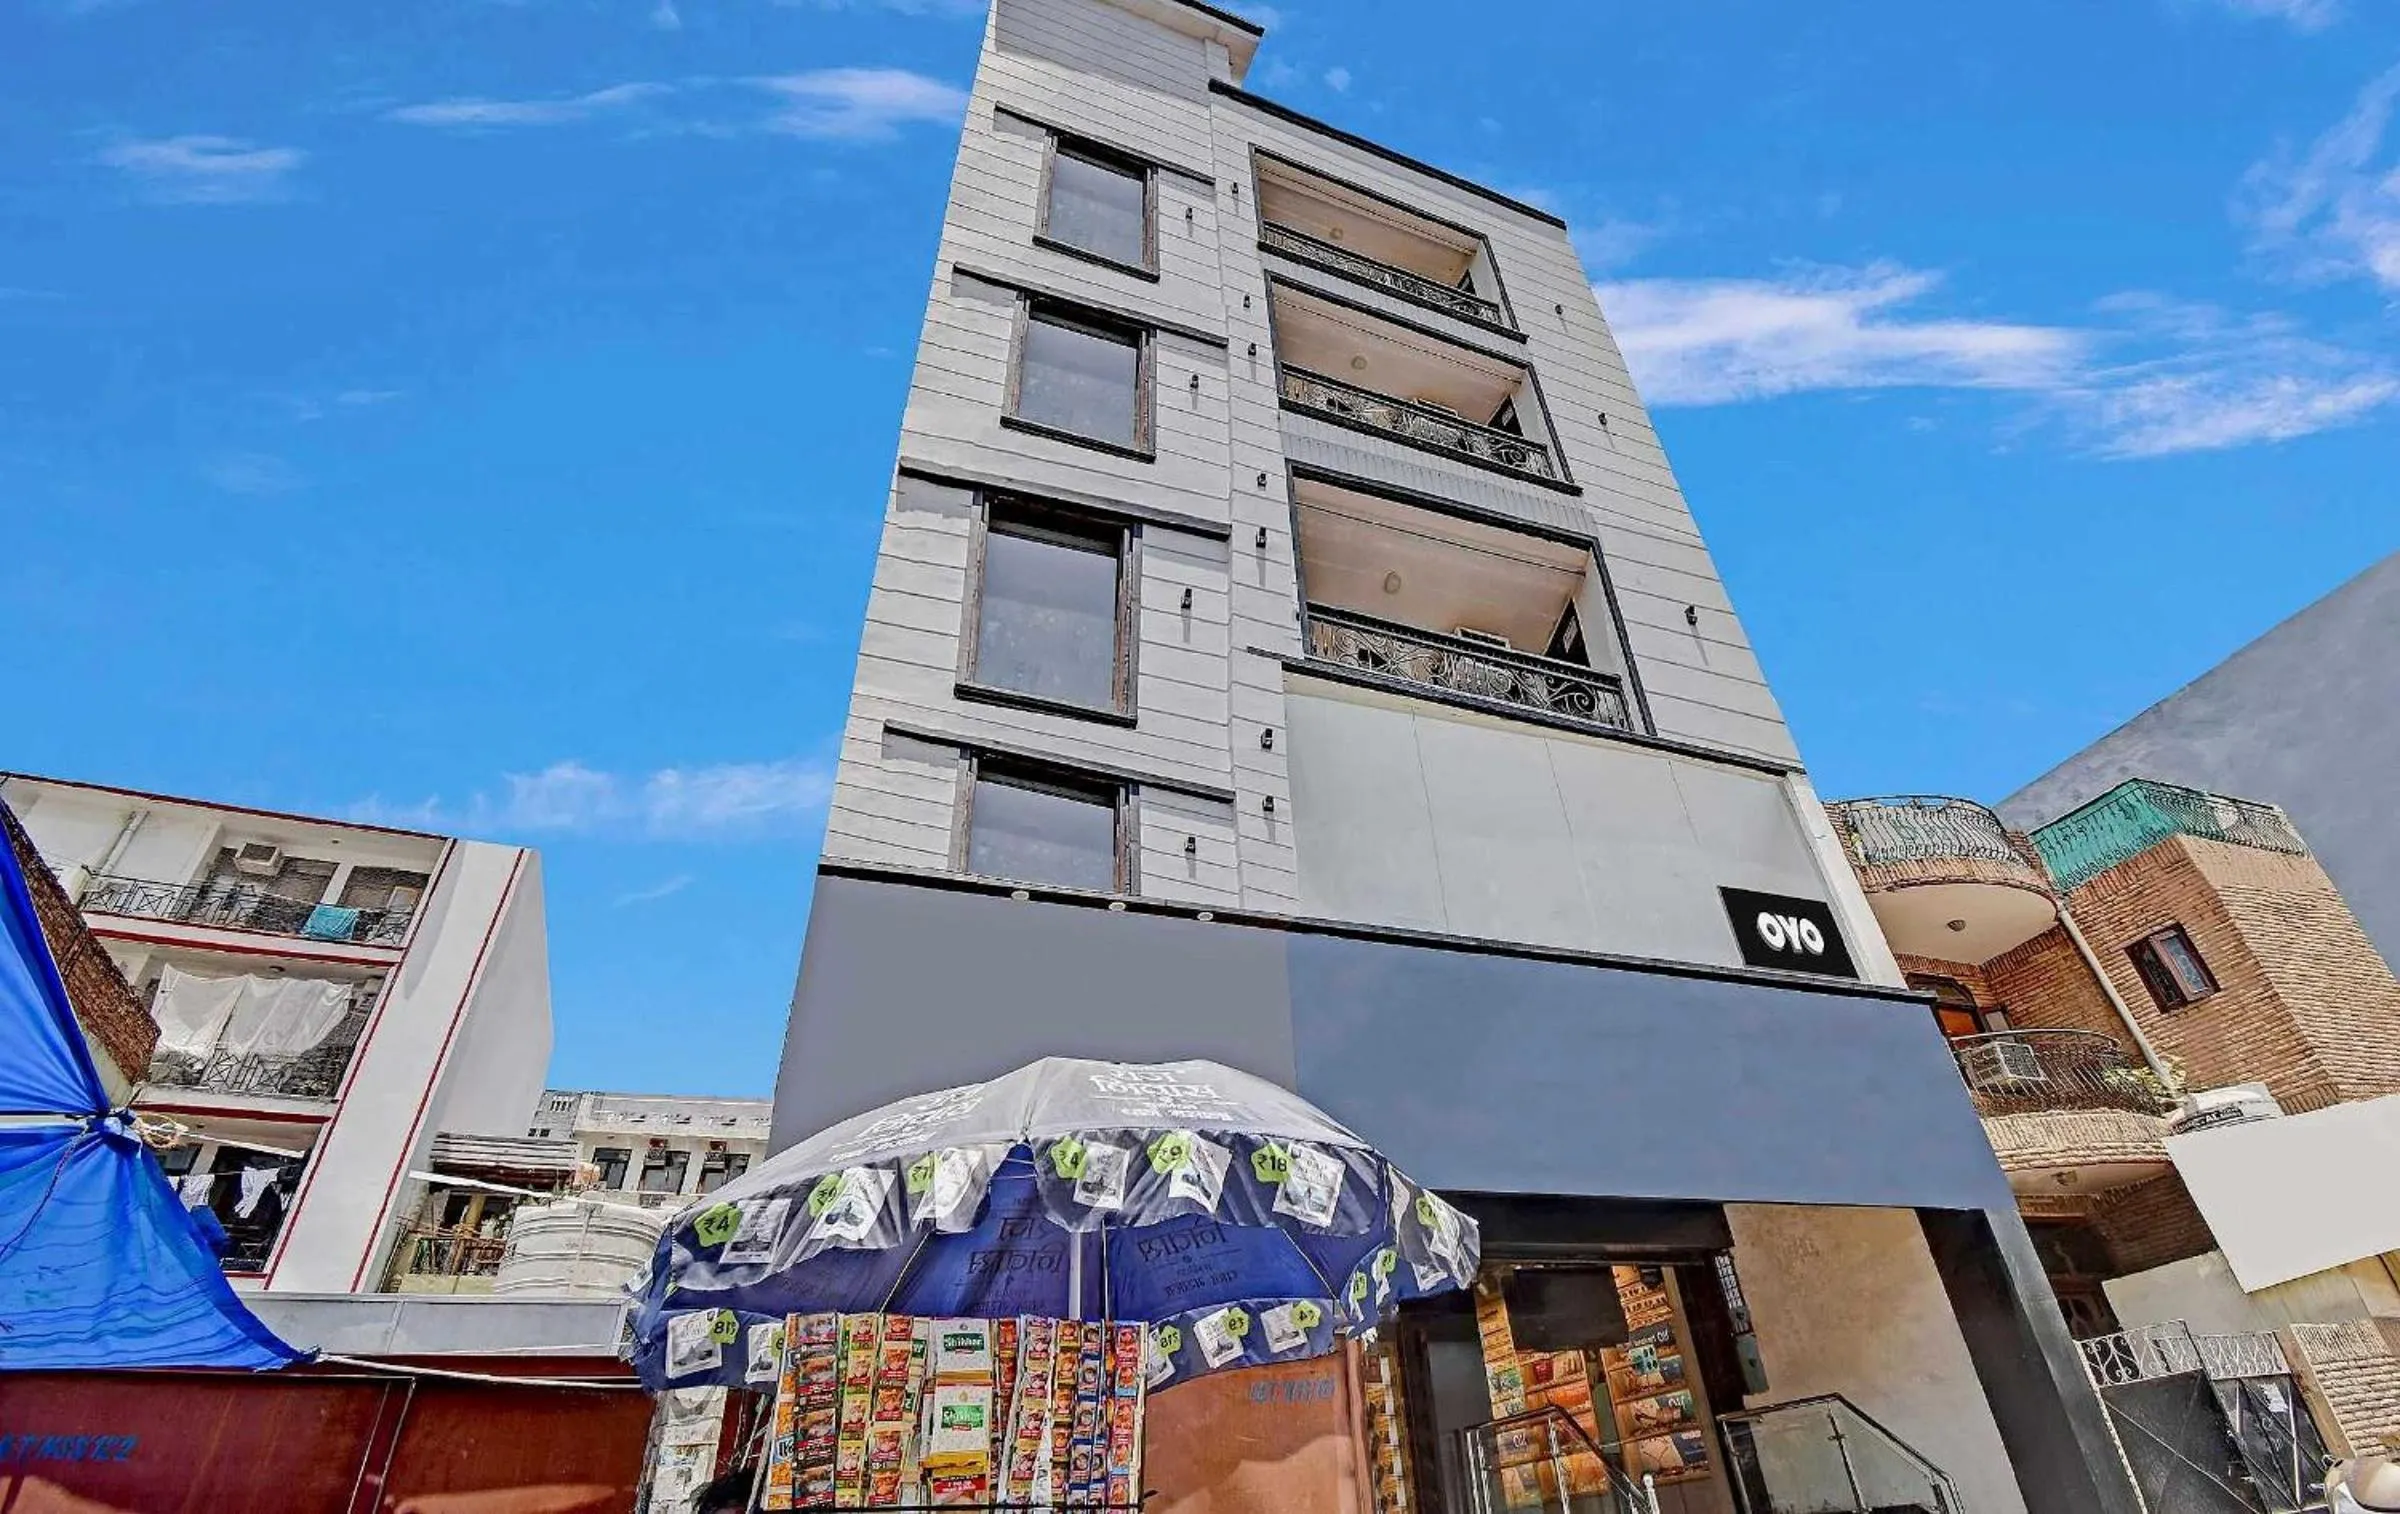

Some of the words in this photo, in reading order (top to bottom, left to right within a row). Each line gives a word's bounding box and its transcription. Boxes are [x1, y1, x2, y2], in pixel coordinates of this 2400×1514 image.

[1757, 912, 1824, 954] OYO
[1257, 1153, 1287, 1172] ₹18
[703, 1216, 729, 1235] ₹4
